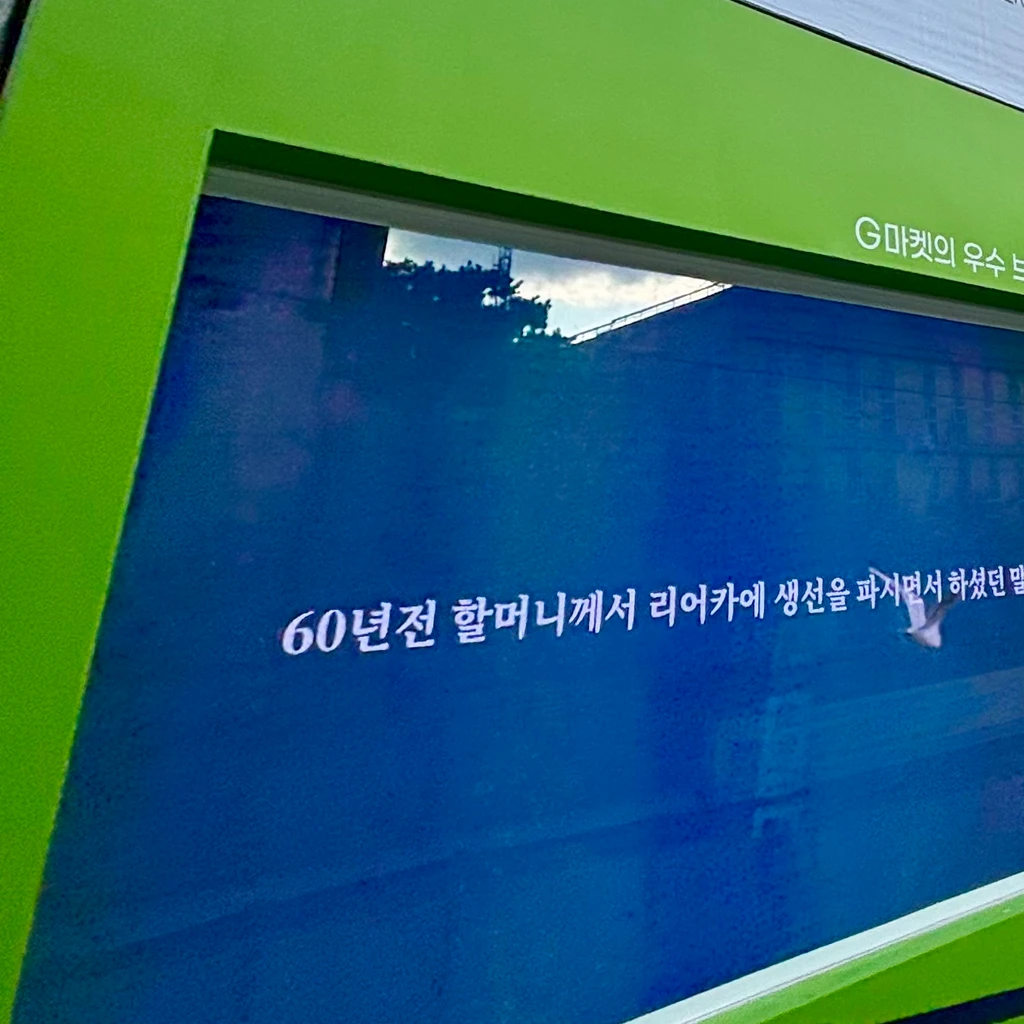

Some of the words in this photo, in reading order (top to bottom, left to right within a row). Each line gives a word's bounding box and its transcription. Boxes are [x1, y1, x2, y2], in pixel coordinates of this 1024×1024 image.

[855, 216, 956, 268] G마켓의
[963, 241, 1006, 278] 우수
[281, 598, 437, 656] 60년전
[451, 587, 636, 645] 할머니께서
[649, 580, 766, 628] 리어카에
[774, 577, 851, 617] 생선을
[856, 569, 942, 610] 파시면서
[948, 566, 1006, 602] 하셨던
